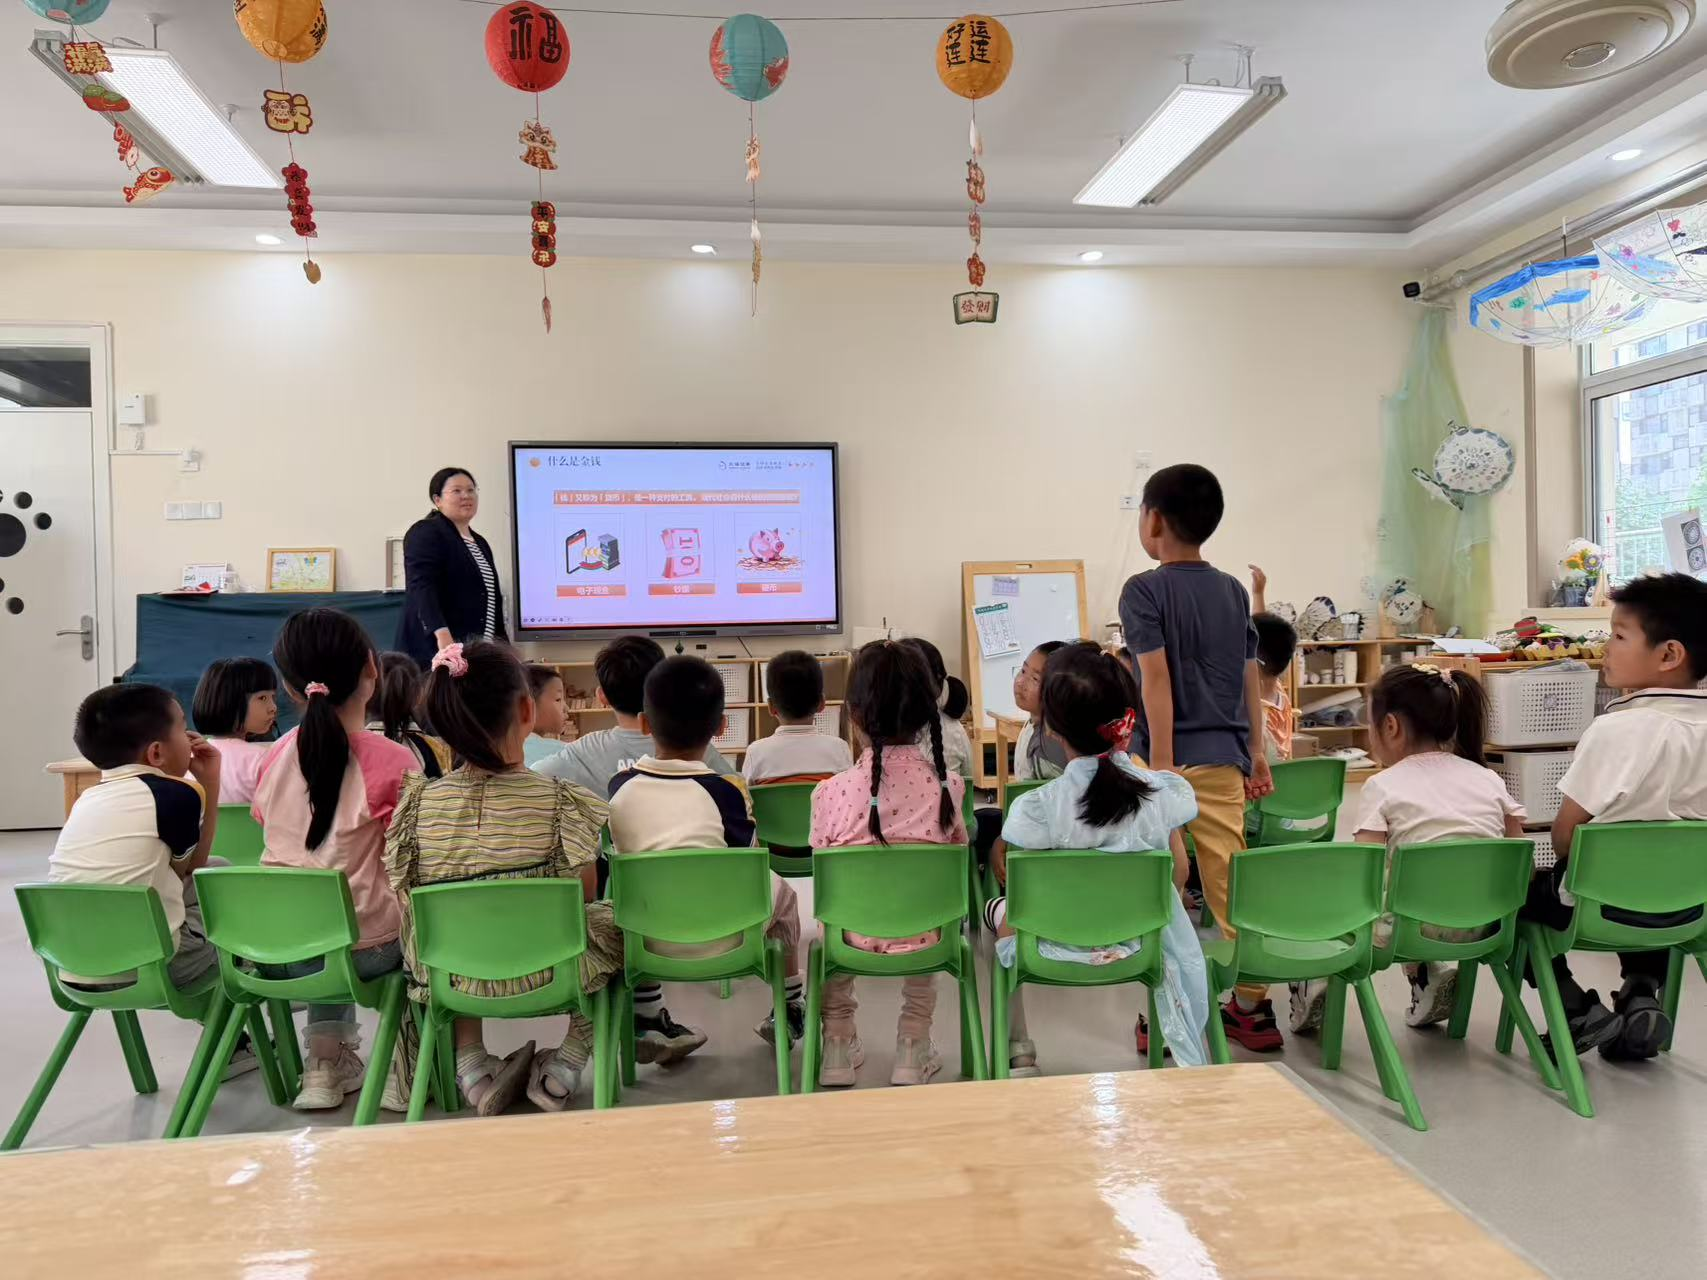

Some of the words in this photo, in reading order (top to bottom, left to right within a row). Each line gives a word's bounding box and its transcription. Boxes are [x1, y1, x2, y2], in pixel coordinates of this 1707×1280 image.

[509, 6, 562, 64] 福
[548, 455, 602, 467] 什么是金钱
